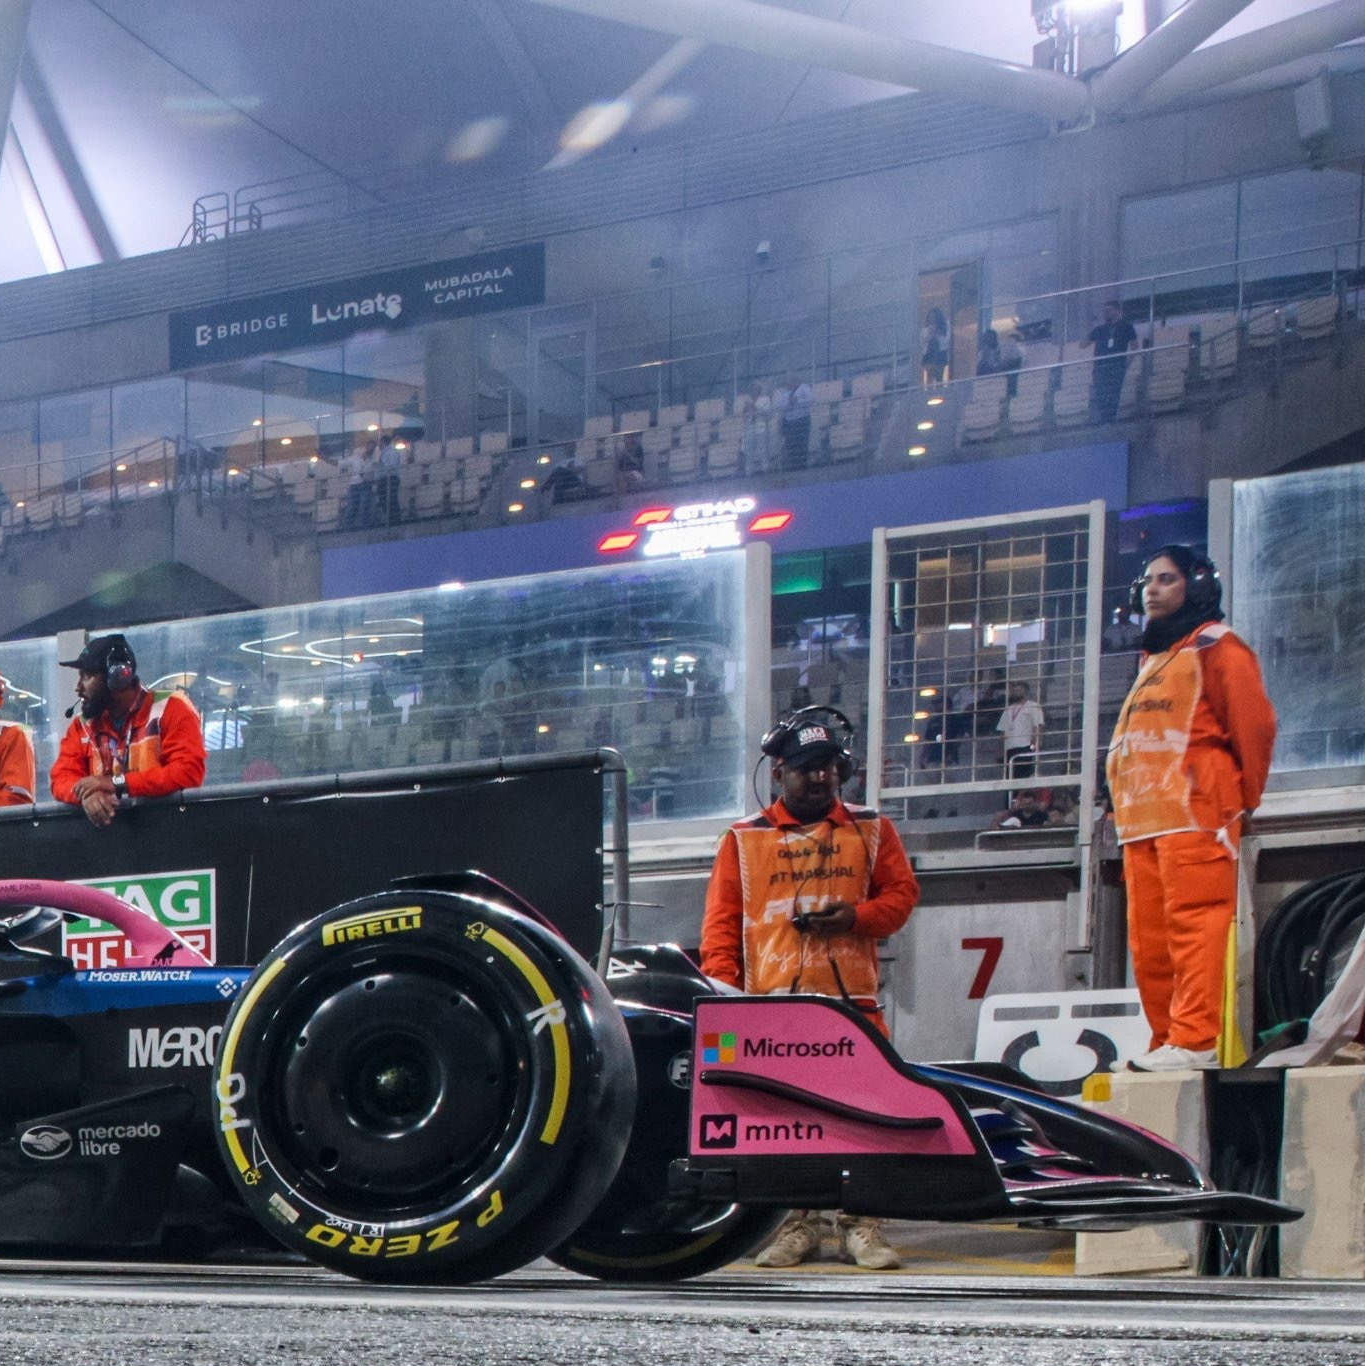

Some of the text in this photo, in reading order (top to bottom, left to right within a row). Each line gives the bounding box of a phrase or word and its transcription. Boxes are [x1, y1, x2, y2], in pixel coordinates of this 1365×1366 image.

[424, 266, 514, 292] MUBADALA
[434, 283, 504, 304] CAPITAL
[218, 313, 289, 339] BRIDGE
[322, 905, 423, 947] PIRELLI
[961, 936, 1004, 1000] 7
[743, 1036, 855, 1058] Microsoft
[78, 1121, 161, 1139] mercado
[745, 1121, 824, 1141] mntn
[80, 1139, 121, 1156] libre
[476, 1189, 505, 1228] P
[305, 1219, 461, 1259] ZERO
